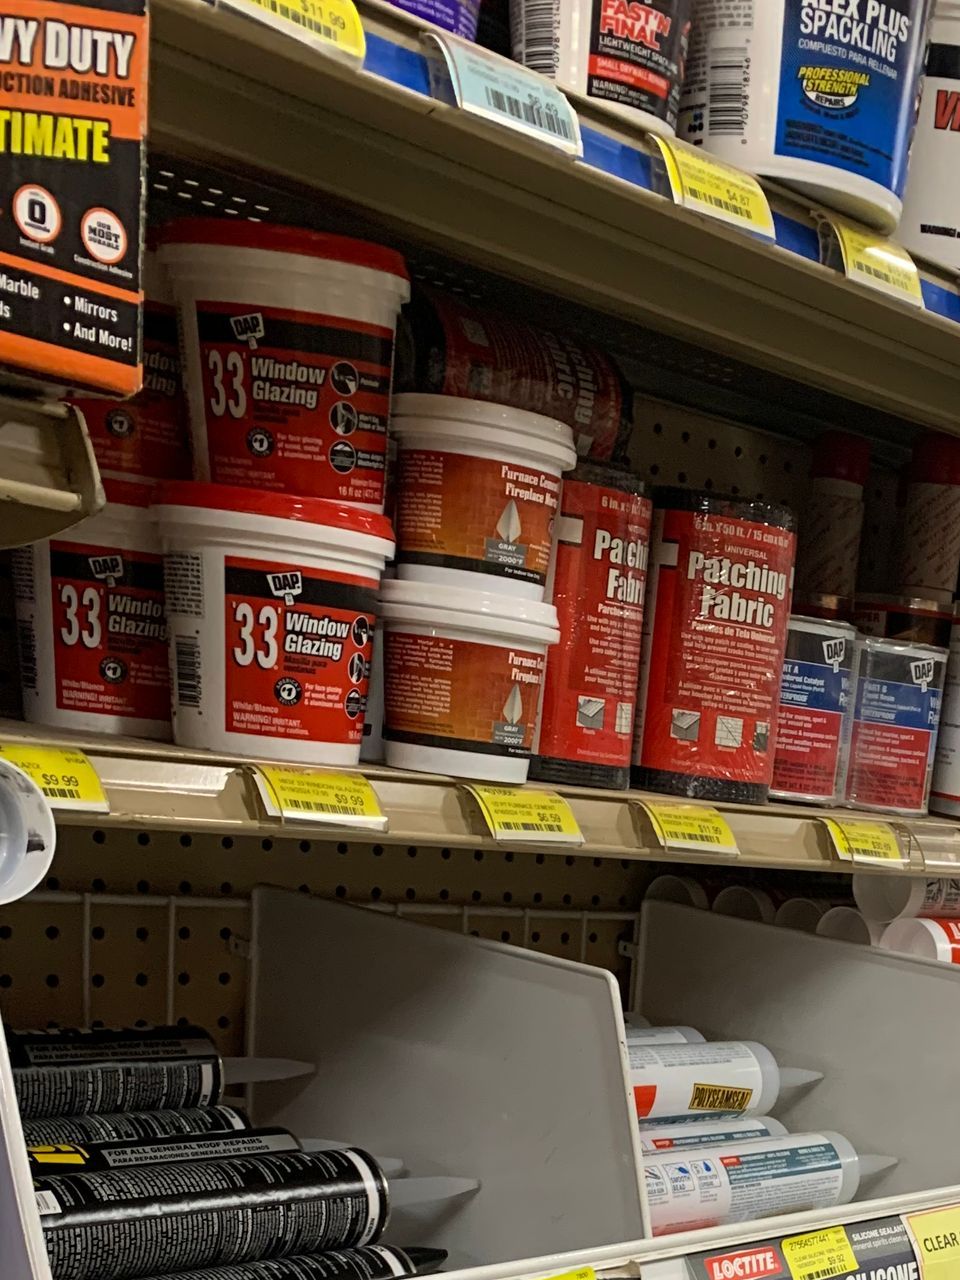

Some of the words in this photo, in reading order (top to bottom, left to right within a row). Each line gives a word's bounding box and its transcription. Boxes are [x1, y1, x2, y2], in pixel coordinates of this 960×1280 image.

[599, 0, 671, 35] FAST'N
[599, 18, 660, 51] FINAL
[600, 36, 651, 59] LIGHTWEIGHT
[800, 10, 897, 62] SPACKLING
[44, 21, 134, 76] DUTY
[798, 66, 870, 88] PROFESSIONAL
[806, 79, 858, 95] STRENGTH
[58, 79, 135, 107] ADHESIVE
[815, 93, 845, 107] REPAIRS
[74, 297, 118, 322] Mirrors
[73, 325, 95, 341] And
[98, 330, 133, 352] More!
[251, 357, 325, 385] Window
[253, 381, 318, 408] Glazing
[502, 466, 538, 487] Furnace
[505, 483, 543, 503] Fireplace
[724, 544, 767, 560] UNIVERSAL
[688, 551, 786, 600] Patching
[700, 586, 774, 628] Fabric
[285, 612, 349, 638] Window
[285, 635, 343, 661] Glazing
[508, 653, 534, 669] Furnace
[691, 1084, 753, 1112] POLYSEAMSEAL
[151, 1144, 195, 1153] GENERAL
[223, 1138, 262, 1147] REPAIRS
[923, 1231, 958, 1253] CLEAR
[713, 1252, 775, 1280] LOCTITE
